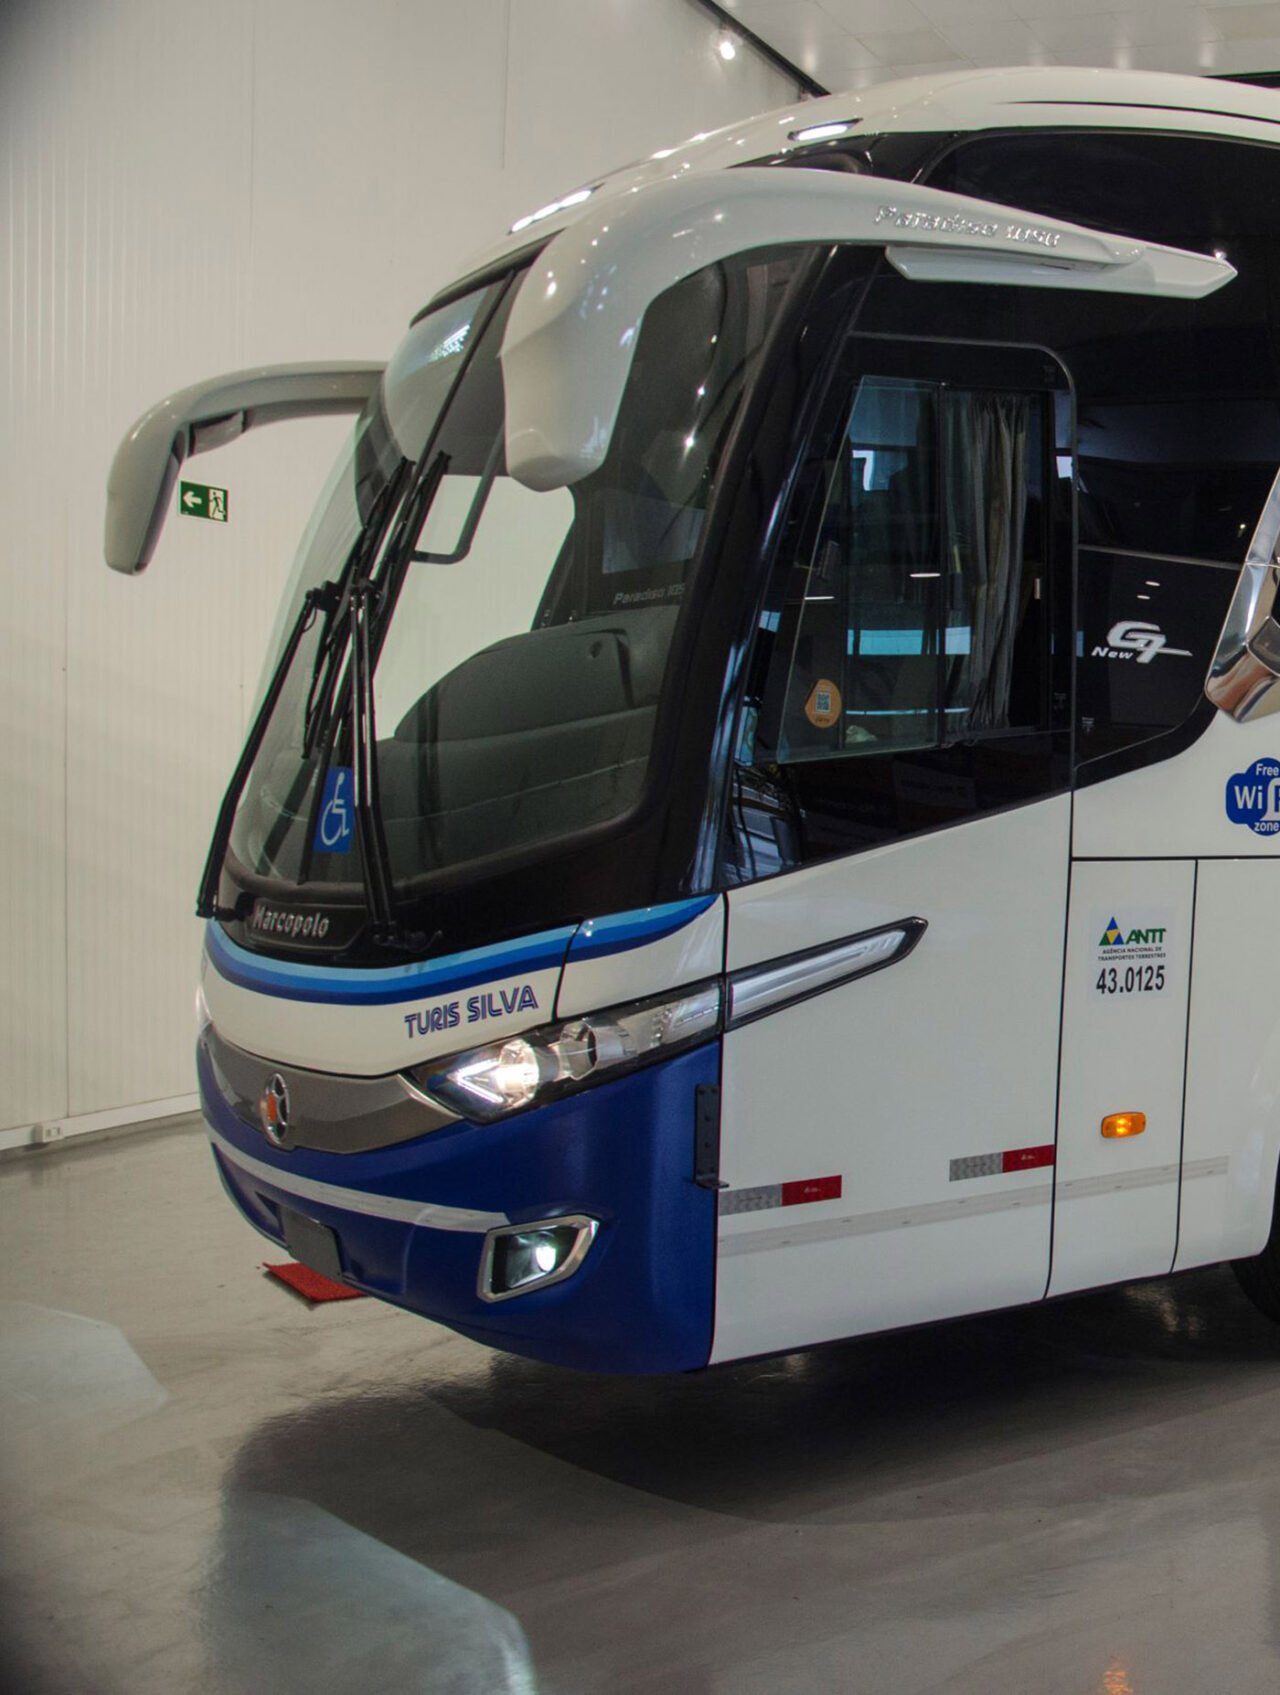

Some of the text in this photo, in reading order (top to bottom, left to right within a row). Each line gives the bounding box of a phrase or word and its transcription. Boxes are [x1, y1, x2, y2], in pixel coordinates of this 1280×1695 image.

[875, 206, 998, 237] Paradiso
[1091, 620, 1193, 664] New G7
[1255, 763, 1280, 776] Free
[1254, 821, 1280, 832] zone
[253, 905, 329, 938] Marcopolo
[1125, 928, 1167, 945] ANTT
[1136, 952, 1166, 960] TERRESTRES
[1096, 965, 1165, 994] 43.0125
[404, 985, 539, 1038] TURIS SILVA
